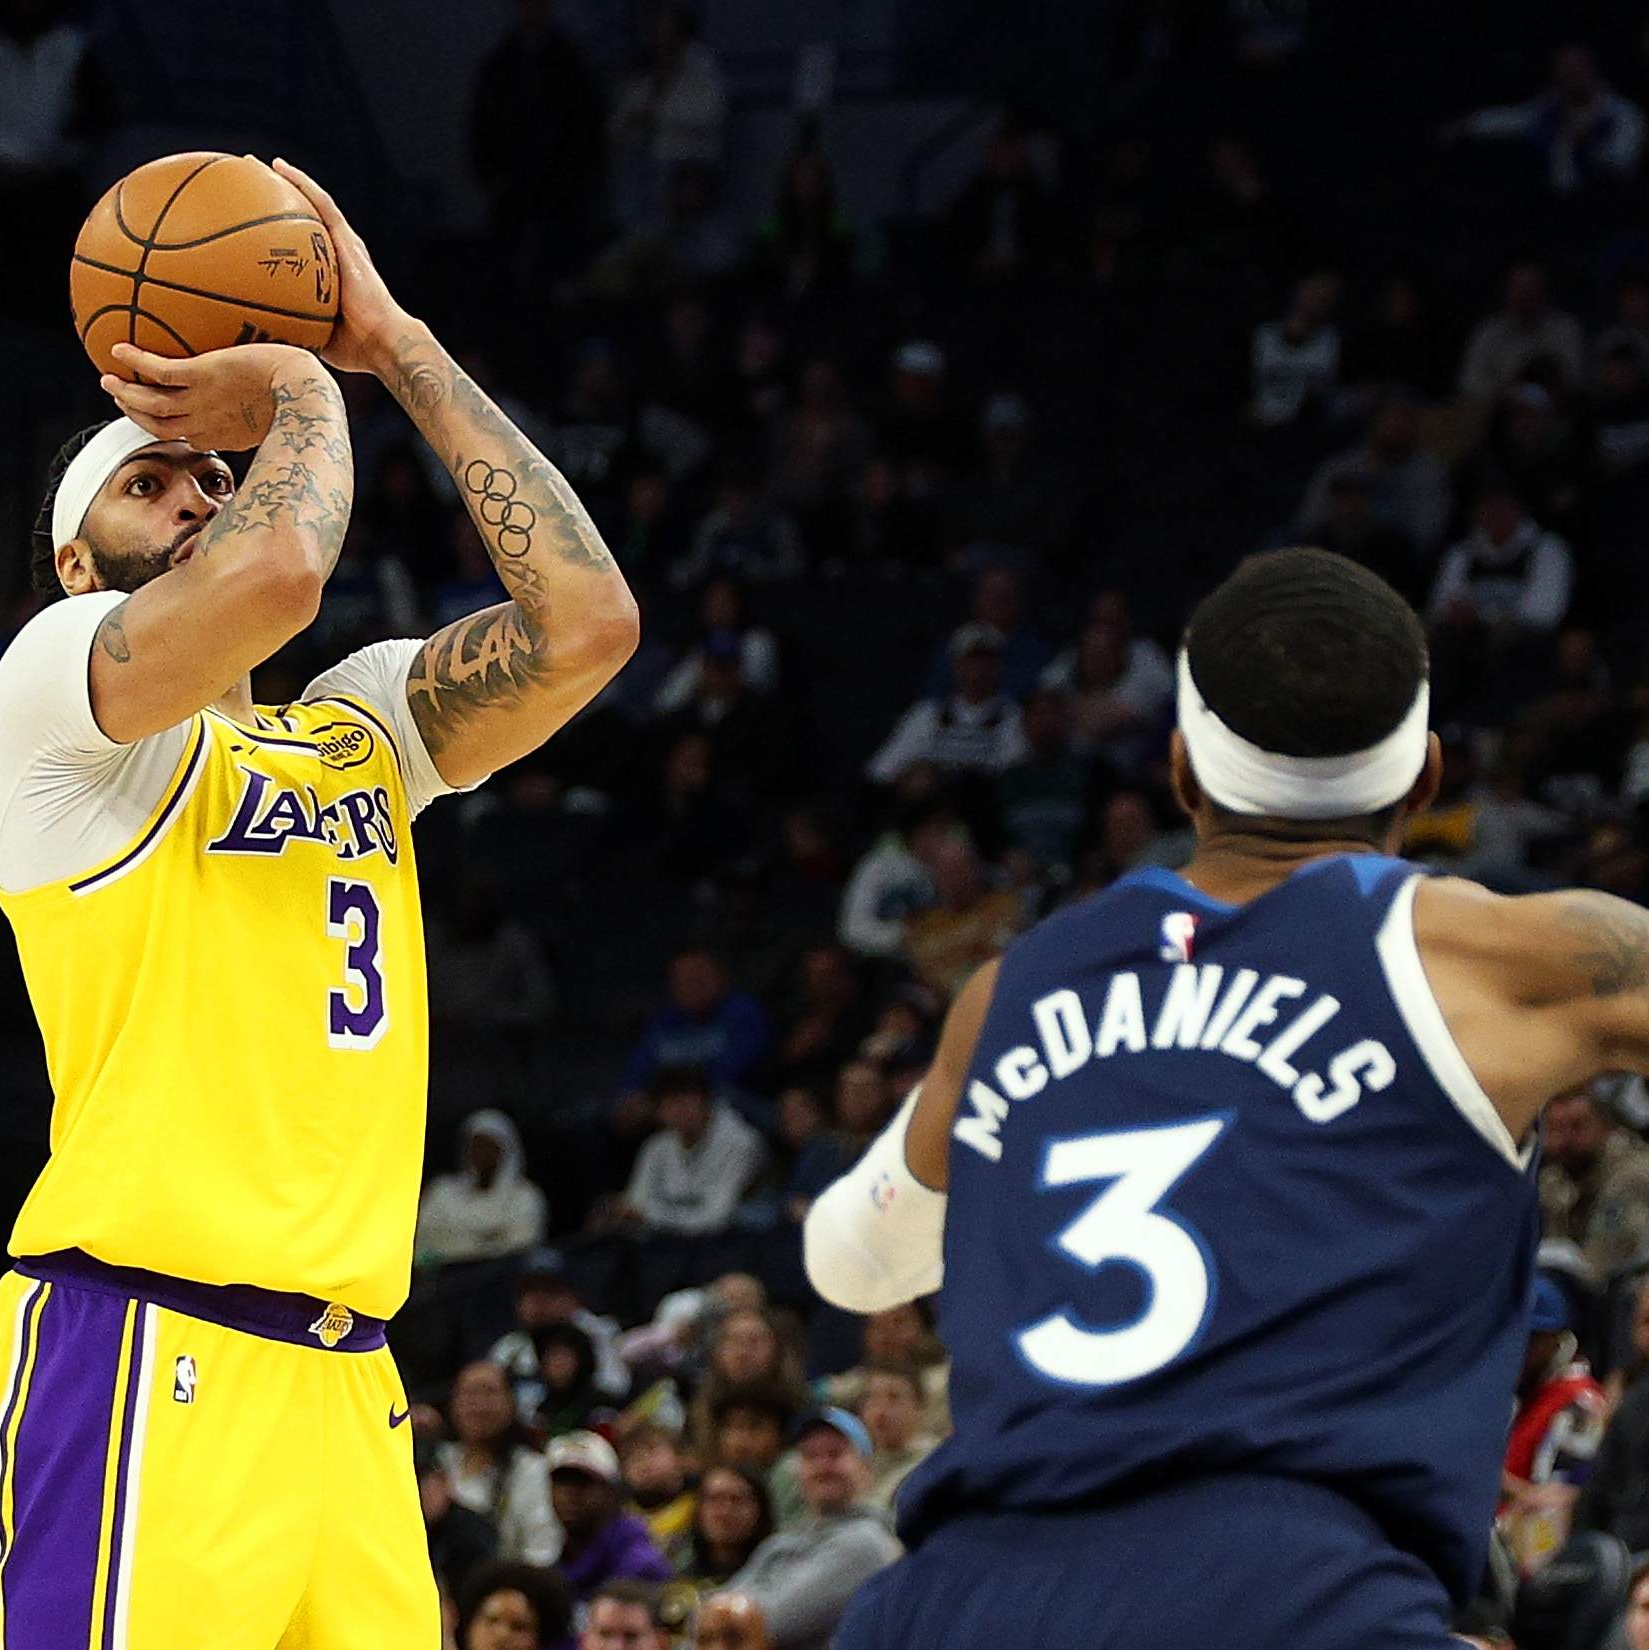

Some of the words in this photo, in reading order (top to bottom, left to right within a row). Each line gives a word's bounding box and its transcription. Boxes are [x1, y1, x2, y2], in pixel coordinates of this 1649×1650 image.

[328, 877, 388, 1049] 3
[953, 964, 1397, 1162] McDANIELS
[1013, 1112, 1232, 1386] 3
